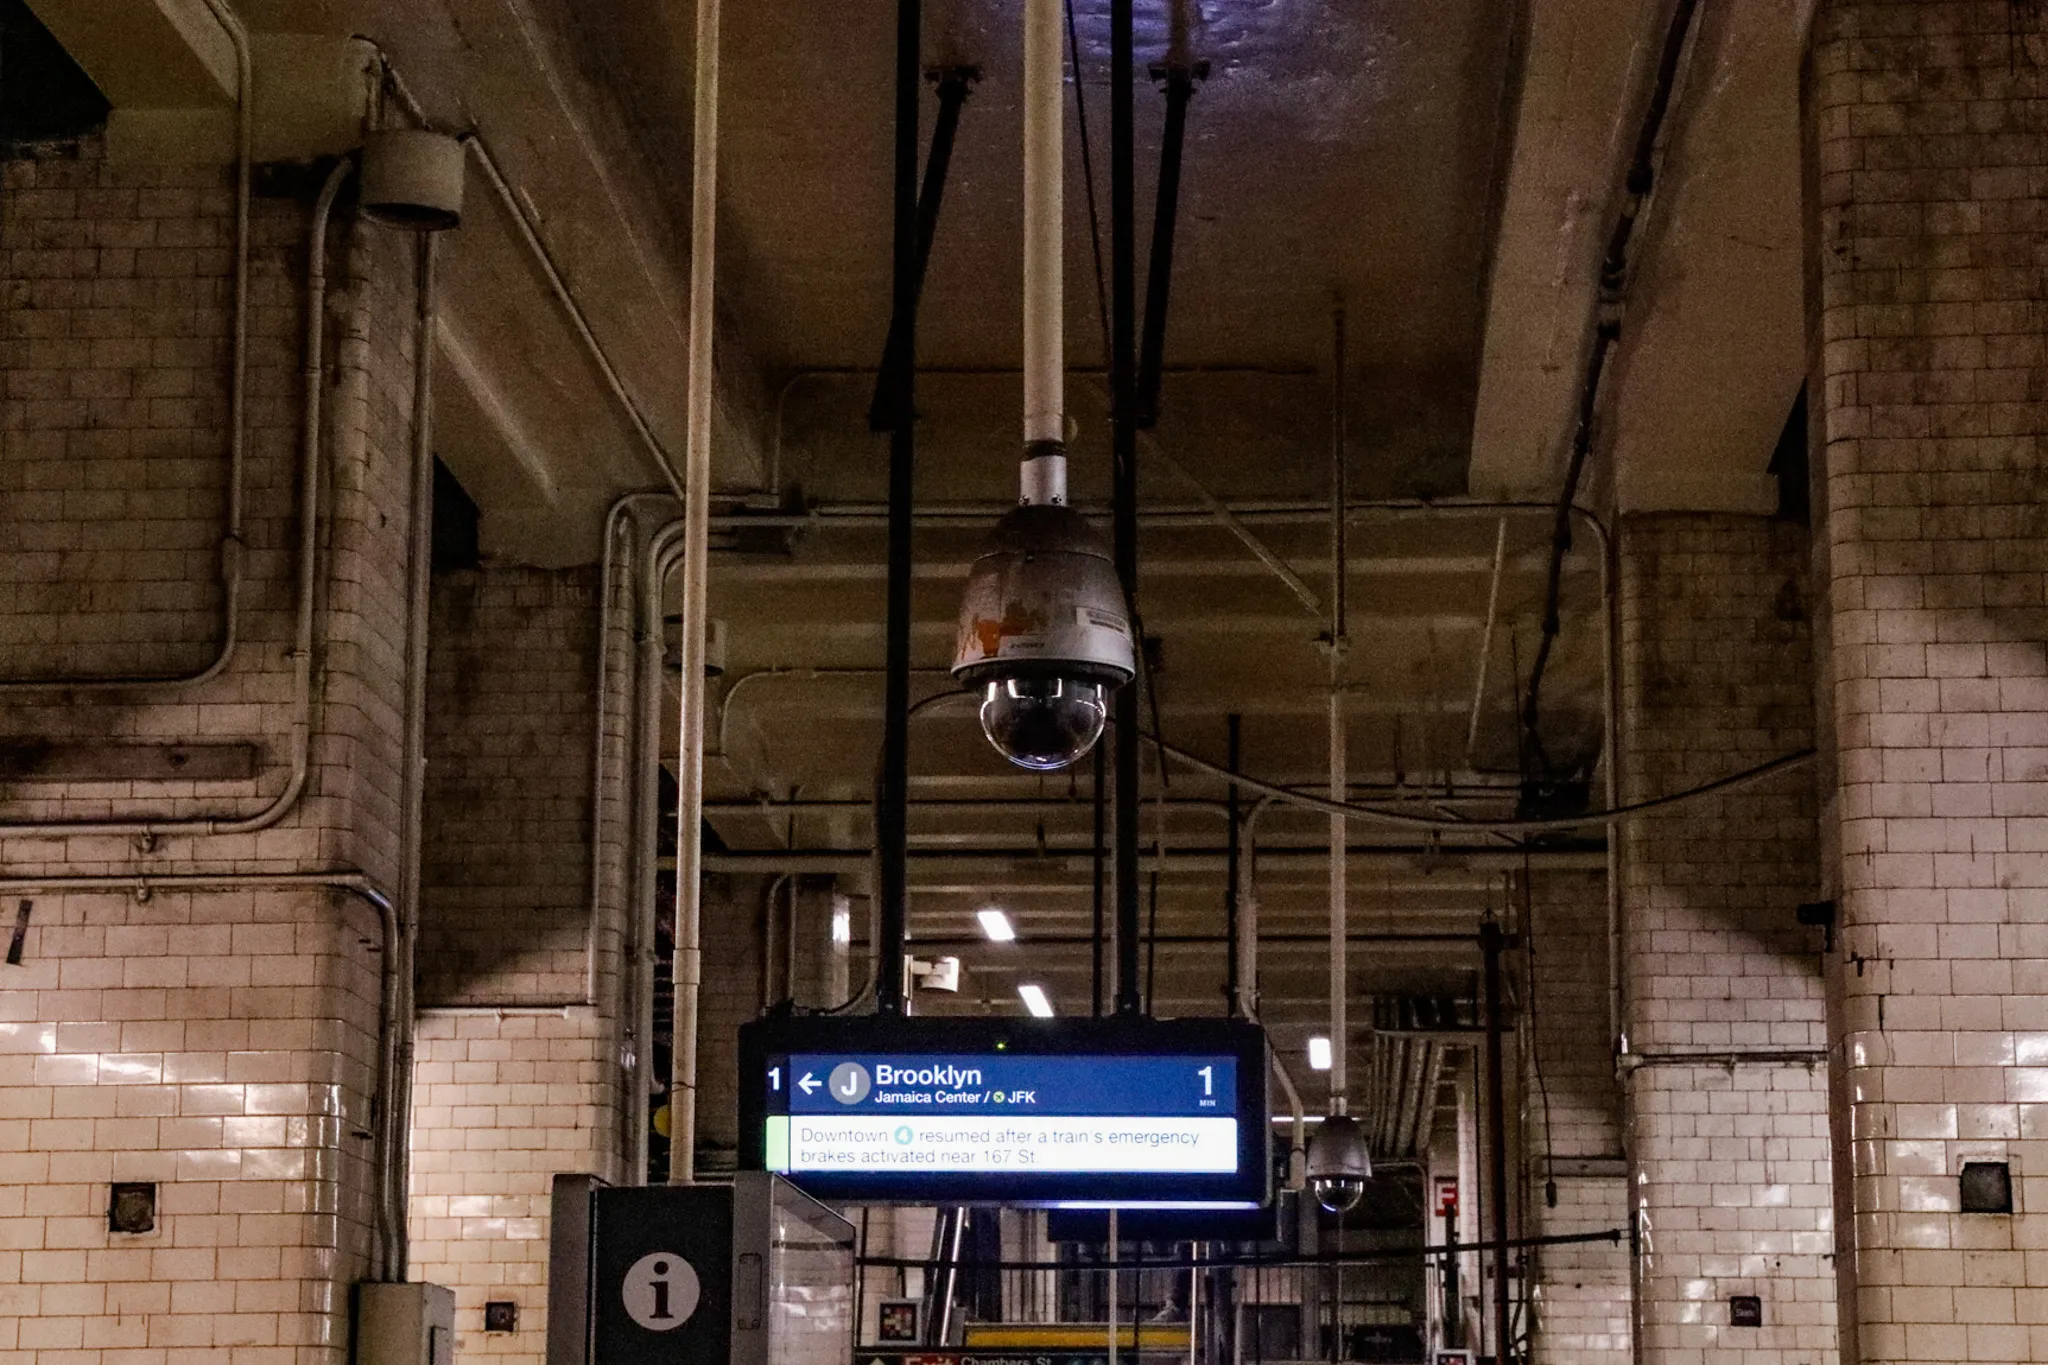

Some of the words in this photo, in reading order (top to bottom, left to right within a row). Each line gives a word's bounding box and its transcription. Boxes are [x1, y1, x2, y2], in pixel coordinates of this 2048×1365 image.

[767, 1067, 780, 1090] 1
[841, 1071, 857, 1096] J
[875, 1064, 982, 1090] Brooklyn
[1197, 1066, 1213, 1096] 1
[875, 1090, 932, 1104] Jamaica
[935, 1090, 981, 1104] Center
[1008, 1090, 1036, 1104] JFK
[1199, 1099, 1216, 1107] MIN
[801, 1127, 888, 1143] Downtown
[919, 1128, 990, 1143] resumed
[996, 1128, 1031, 1143] after
[1038, 1133, 1047, 1143] a
[1108, 1132, 1200, 1147] emergency
[801, 1149, 856, 1164] brakes
[861, 1149, 935, 1164] activated
[941, 1152, 976, 1164] near
[984, 1150, 1011, 1164] 167
